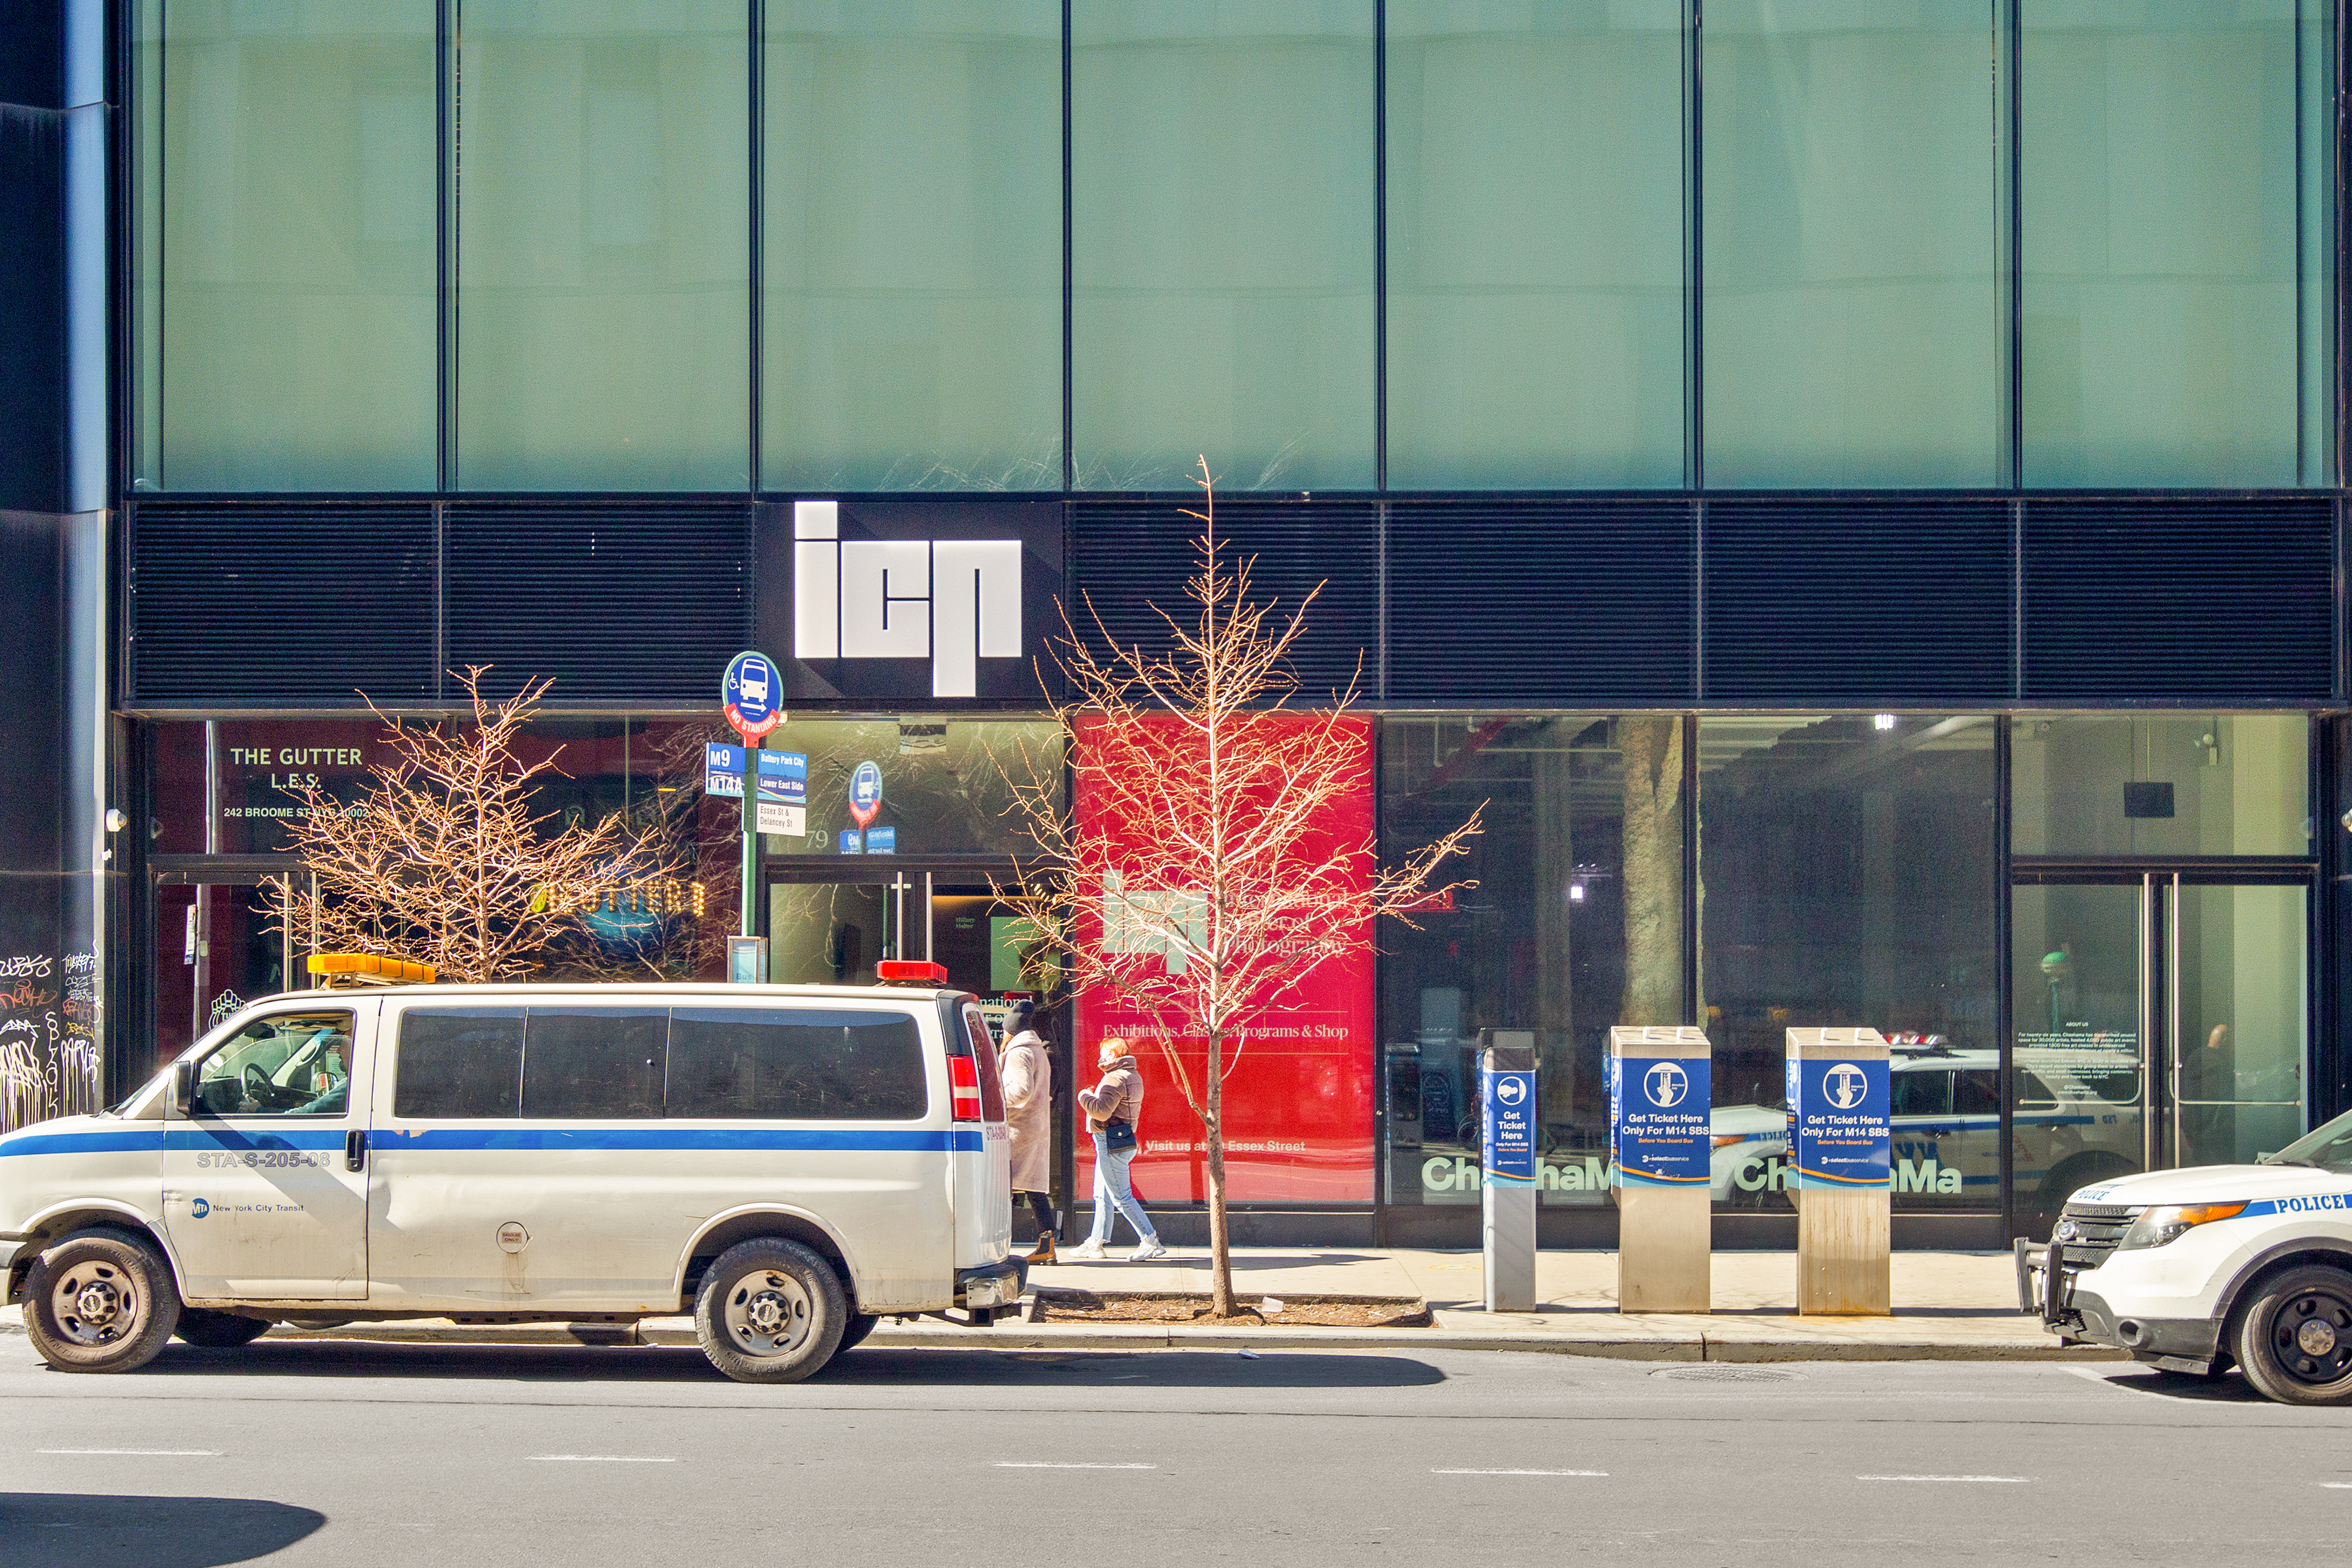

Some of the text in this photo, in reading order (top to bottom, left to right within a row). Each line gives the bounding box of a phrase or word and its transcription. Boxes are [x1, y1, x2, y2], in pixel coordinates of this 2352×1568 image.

[795, 501, 1022, 697] icp
[731, 711, 777, 733] NO STANDING
[230, 748, 362, 765] THE GUTTER
[710, 749, 731, 767] M9
[761, 753, 804, 768] Battery Park City
[271, 774, 321, 789] L.E.S.
[710, 775, 743, 795] M14A
[760, 778, 804, 791] Lower East Side
[224, 808, 242, 817] 242
[245, 808, 294, 817] BROOME
[296, 808, 310, 817] ST
[760, 806, 776, 815] Essex
[760, 816, 793, 828] Delancey St
[806, 830, 828, 849] 79
[1103, 1024, 1349, 1041] Exhibitions, Class, Programs & Shop
[1504, 1111, 1520, 1120] Get
[1628, 1114, 1703, 1123] Get Ticket Here
[1808, 1115, 1883, 1124] Get Ticket Here
[1623, 1126, 1645, 1136] Only
[1689, 1127, 1710, 1135] SBS
[1802, 1128, 1889, 1138] Only For M14 SBS
[1146, 1140, 1206, 1151] Visit us at
[1228, 1140, 1264, 1151] Essex
[1267, 1140, 1305, 1151] Street
[197, 1152, 330, 1167] STA-S-205-08
[2277, 1195, 2343, 1213] POLICE
